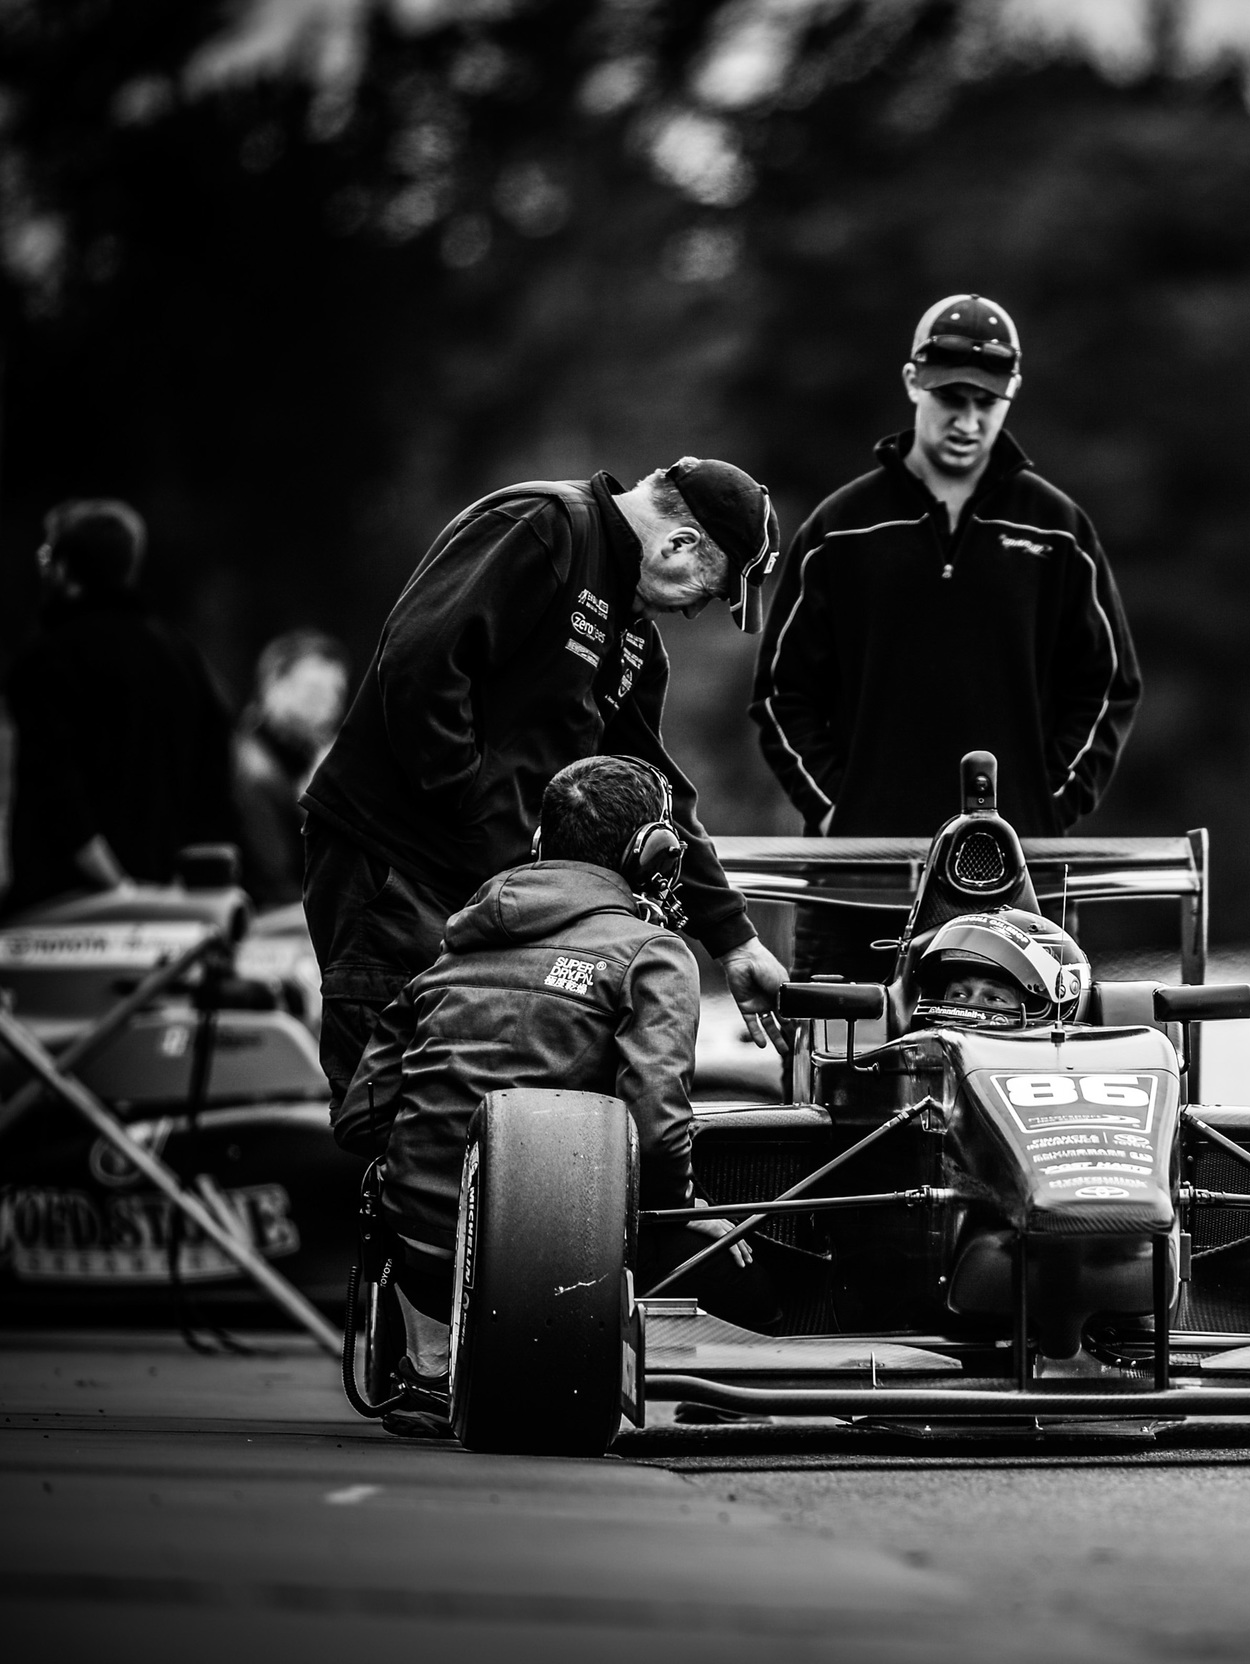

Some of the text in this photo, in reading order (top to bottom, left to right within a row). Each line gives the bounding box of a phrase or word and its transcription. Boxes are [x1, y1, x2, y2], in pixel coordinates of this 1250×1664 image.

[573, 616, 594, 635] zero
[1006, 926, 1029, 944] SHOP
[556, 956, 595, 975] SUPER
[1006, 1076, 1150, 1107] 86
[465, 1186, 475, 1284] MICHELIN
[379, 1258, 393, 1287] TOYOTA
